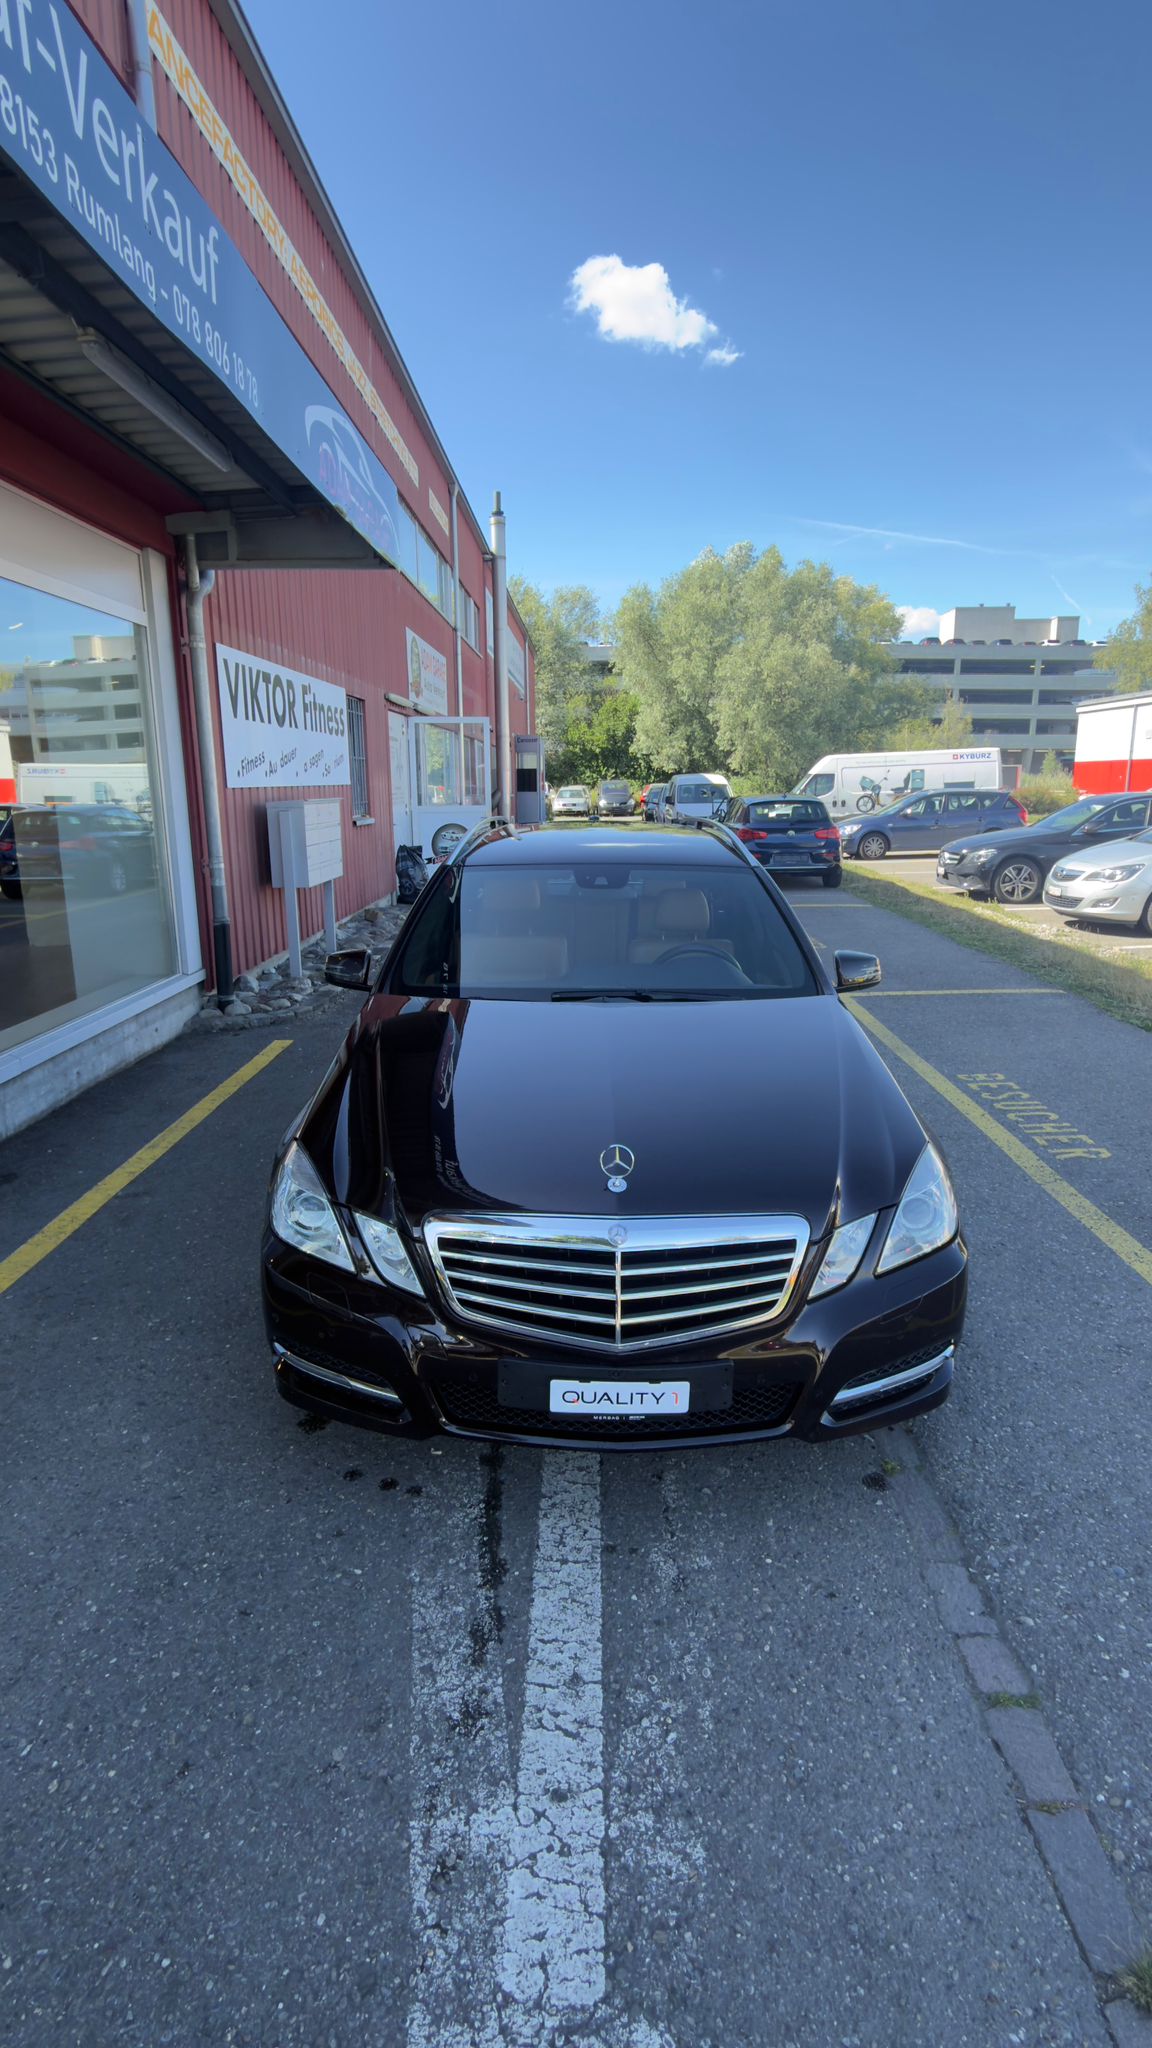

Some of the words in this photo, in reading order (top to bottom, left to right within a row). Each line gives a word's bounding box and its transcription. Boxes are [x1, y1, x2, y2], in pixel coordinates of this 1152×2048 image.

[0, 74, 58, 183] 8153
[173, 284, 201, 345] 078
[205, 321, 230, 376] 806
[233, 351, 245, 391] 18
[246, 367, 259, 407] 78
[223, 657, 300, 729] VIKTOR
[301, 682, 346, 737] Fitness
[240, 751, 266, 777] Fitness
[956, 1073, 1113, 1161] BESUCHER
[562, 1391, 666, 1405] QUALITY
[672, 1391, 679, 1405] 1
